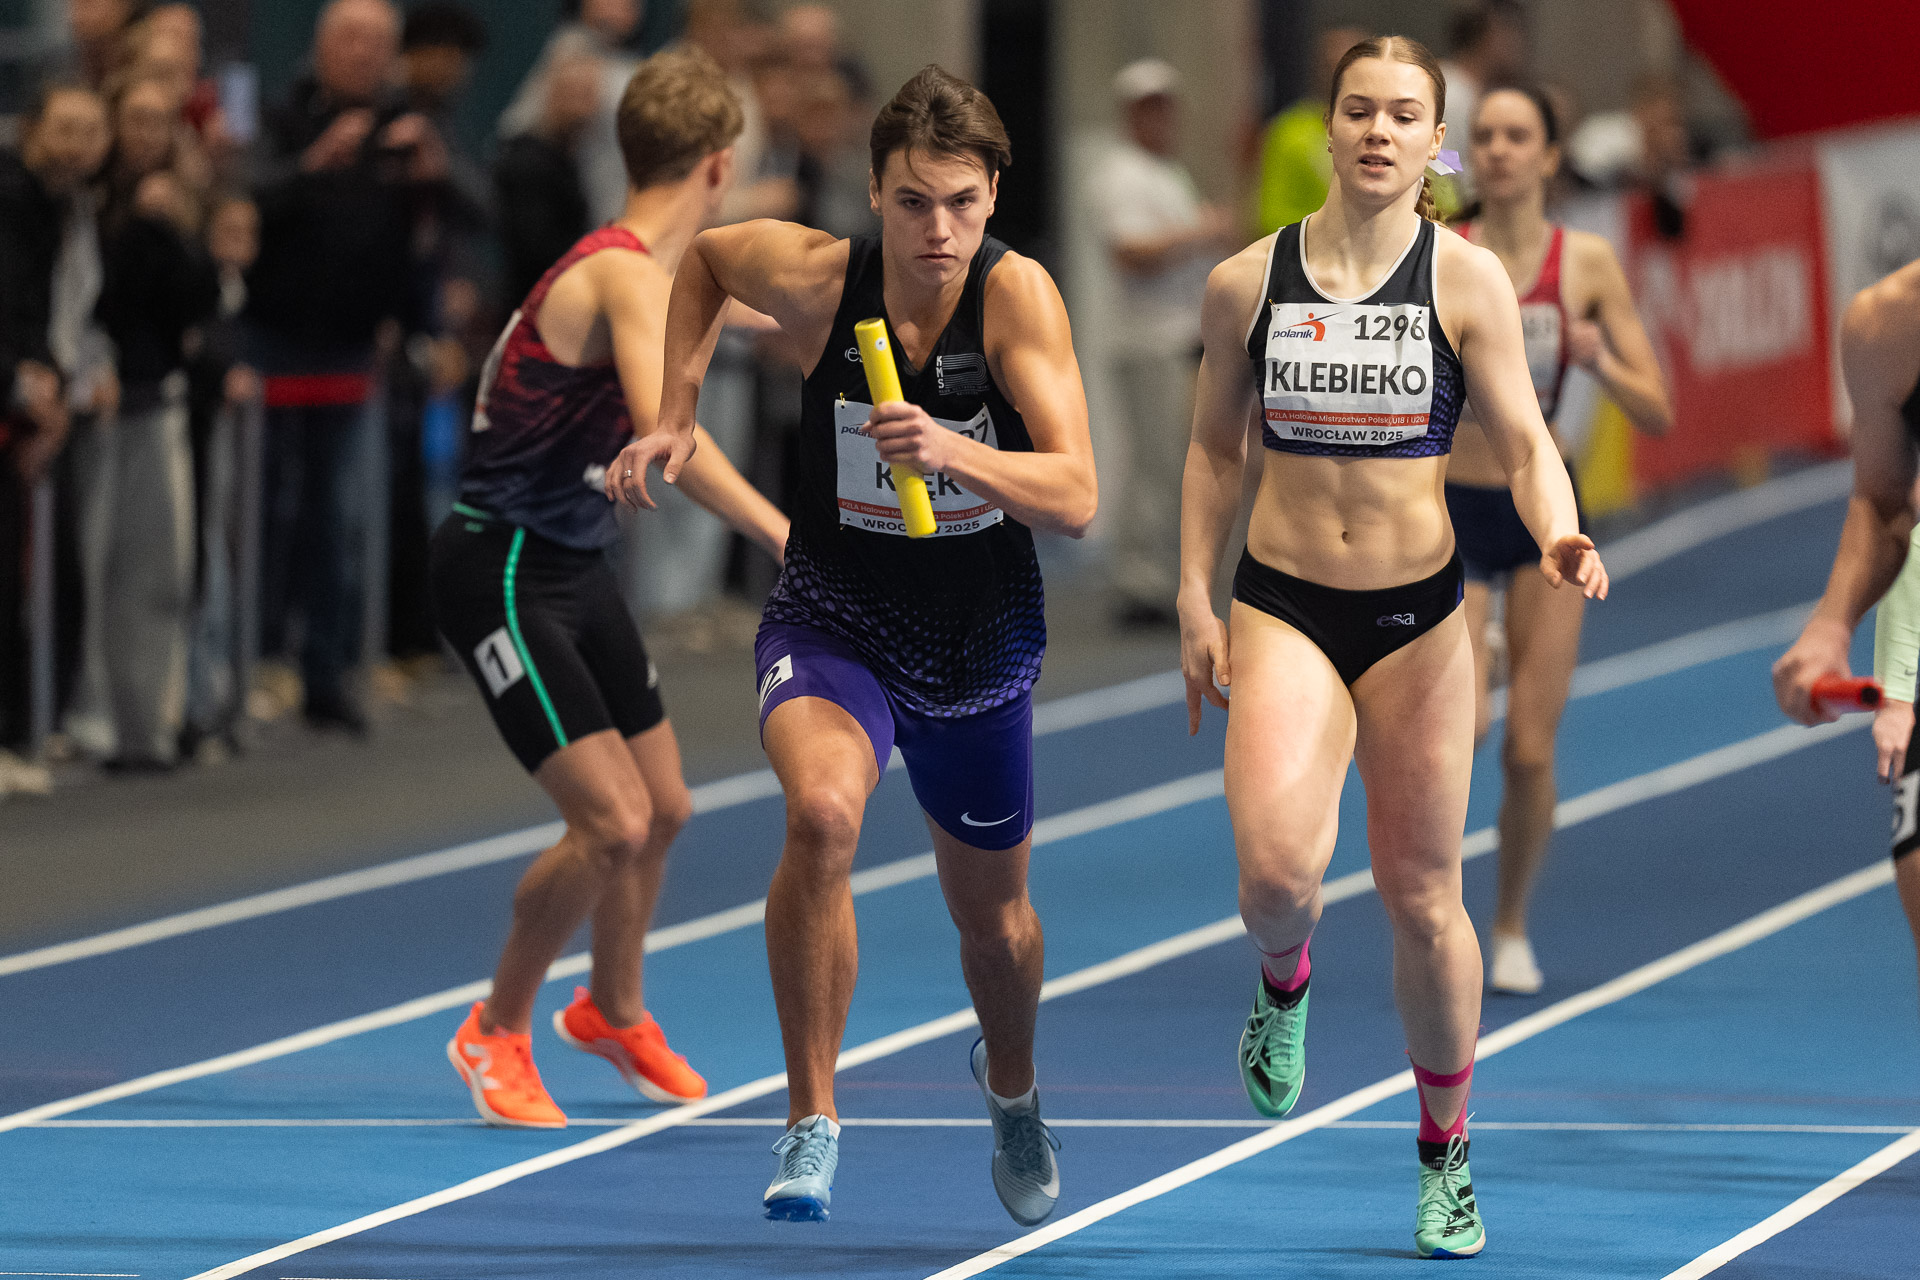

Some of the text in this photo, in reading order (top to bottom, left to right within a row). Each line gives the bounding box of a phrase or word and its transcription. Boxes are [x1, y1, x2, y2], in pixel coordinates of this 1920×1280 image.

[1272, 329, 1314, 340] polanik
[1354, 314, 1426, 342] 1296
[1270, 361, 1427, 396] KLEBIEKO
[1269, 411, 1288, 420] PZLA
[1289, 412, 1318, 421] Halowe
[1319, 415, 1367, 424] Mistrzostwa
[1410, 415, 1425, 424] U20
[1291, 426, 1404, 442] WROCŁAW 2025
[841, 501, 860, 511] PZLA
[860, 504, 890, 516] Halowe
[944, 519, 980, 533] 2025
[761, 665, 783, 704] 2
